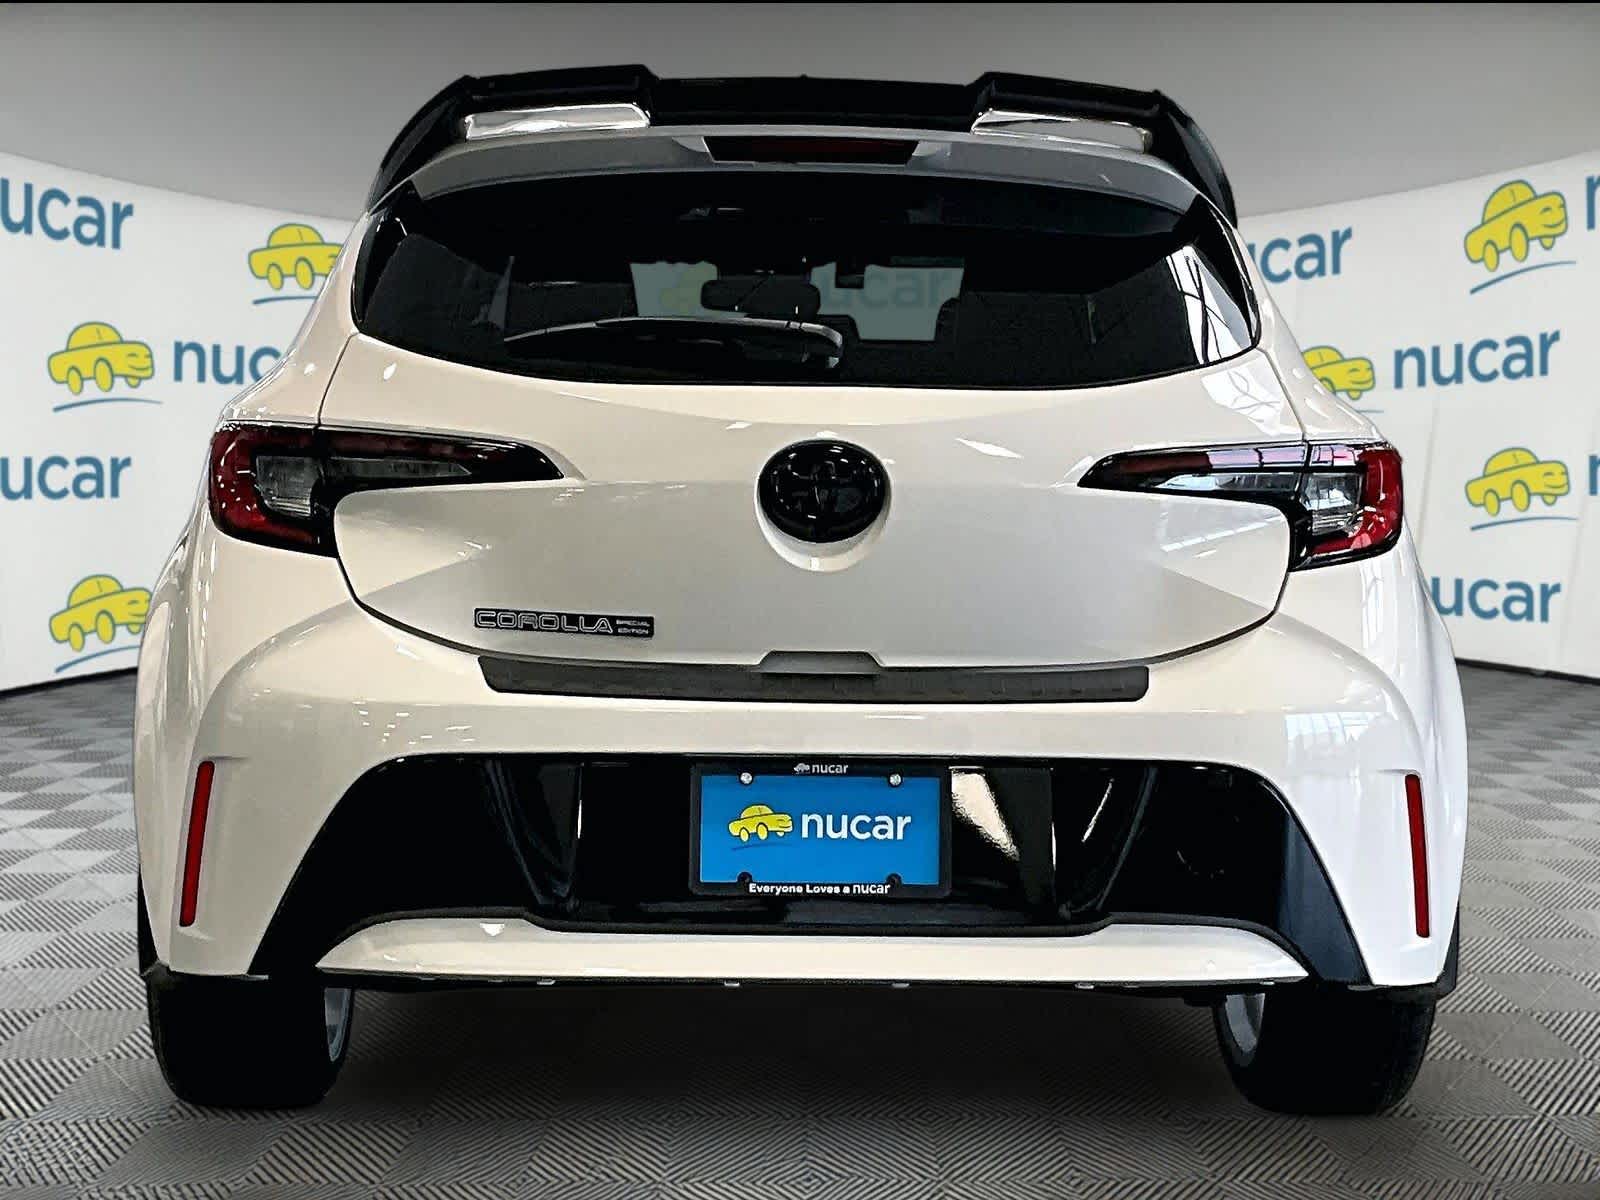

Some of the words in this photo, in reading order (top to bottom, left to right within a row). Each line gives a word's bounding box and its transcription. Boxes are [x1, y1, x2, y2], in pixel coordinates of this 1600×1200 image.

[0, 178, 134, 250] ucar
[1248, 227, 1352, 284] car
[173, 341, 281, 385] nuc
[1394, 331, 1561, 389] nucar
[0, 455, 131, 501] ucar
[1430, 576, 1562, 622] ucar
[475, 610, 613, 634] COROLLA
[811, 762, 849, 774] nucar
[801, 813, 912, 840] nucar
[749, 883, 803, 895] Everyone
[805, 883, 841, 894] Loves
[843, 886, 851, 894] a
[852, 883, 891, 894] nucar
